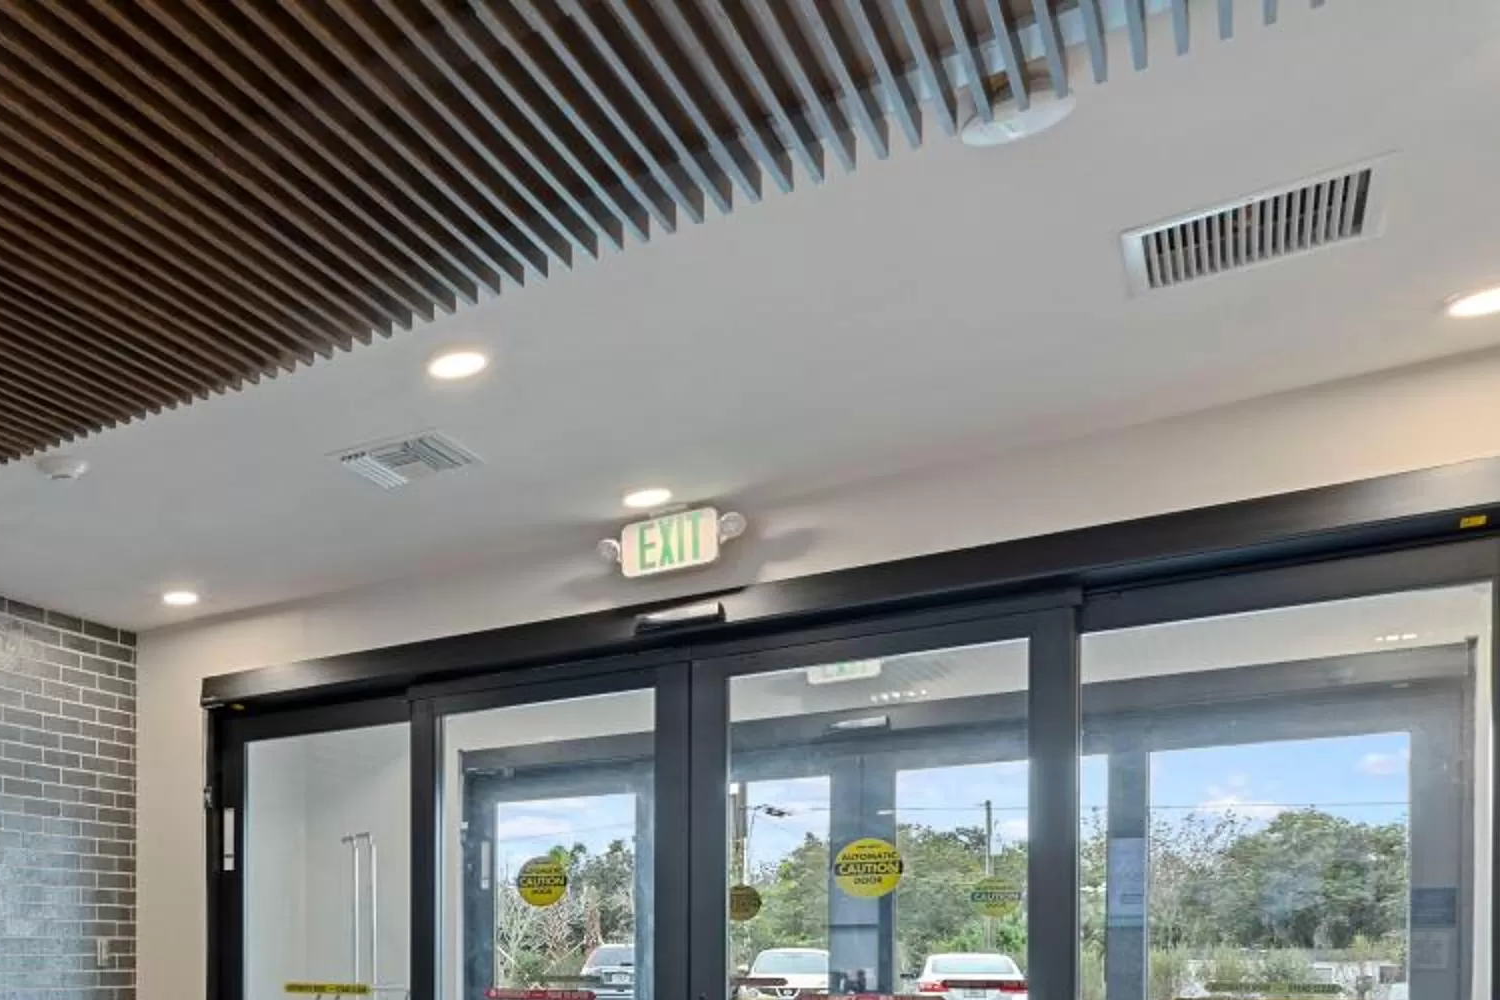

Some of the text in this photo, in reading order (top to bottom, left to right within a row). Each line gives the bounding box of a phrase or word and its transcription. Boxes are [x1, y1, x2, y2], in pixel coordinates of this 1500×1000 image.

[638, 511, 702, 570] EXIT
[842, 851, 898, 861] AUTOMATIC
[839, 862, 899, 874] CAUTION
